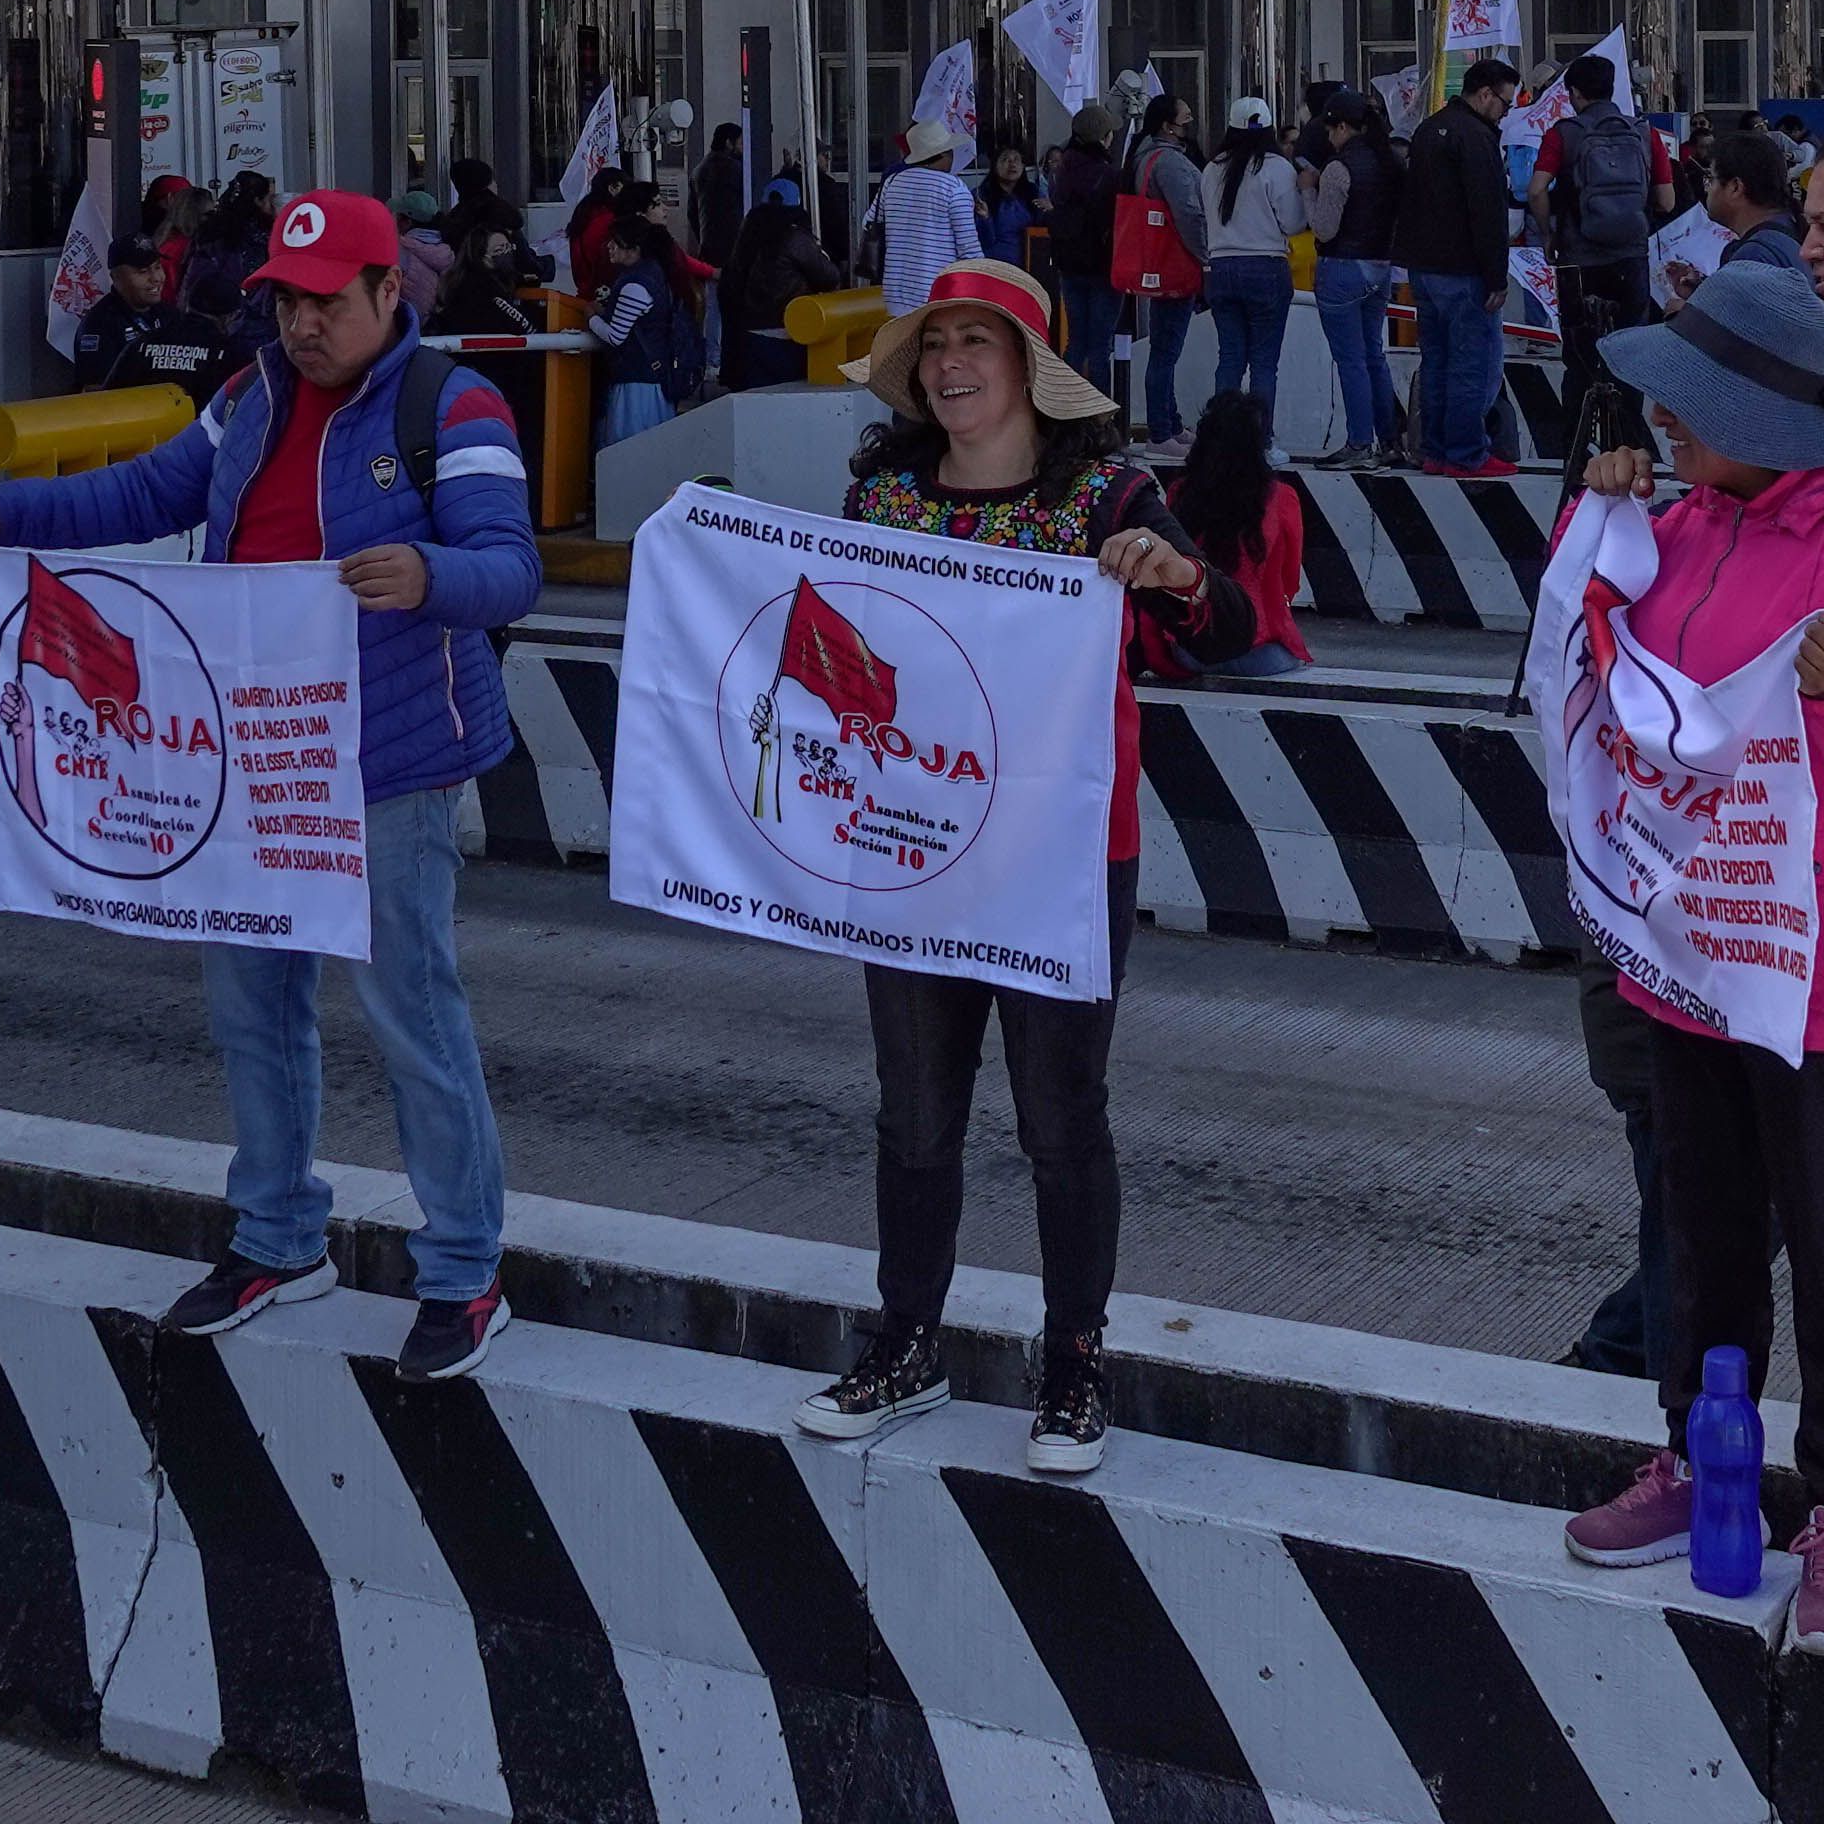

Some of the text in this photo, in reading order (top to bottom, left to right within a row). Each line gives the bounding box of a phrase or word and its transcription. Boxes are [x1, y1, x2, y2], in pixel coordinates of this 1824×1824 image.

[152, 357, 197, 371] FEDERAL
[686, 505, 1083, 597] ASAMBLEA DE COORDINACIÓN SECCIÓN 10
[232, 687, 300, 708] AUMENTO A LAS
[92, 697, 222, 757] ROJA
[236, 715, 331, 741] NO AL PAGO EN UMA
[241, 752, 253, 773] EN
[255, 751, 267, 773] EL
[838, 711, 990, 786] ROJA
[55, 754, 110, 780] CNTE
[114, 773, 201, 808] Asamblea de
[249, 782, 287, 804] PRONTA
[288, 782, 295, 803] Y
[798, 772, 856, 802] CNTE
[1737, 779, 1768, 806] UMA
[254, 815, 283, 835] BAJOS
[283, 814, 323, 836] INTERESES
[861, 793, 959, 834] Asamblea de
[87, 815, 175, 856] Sección 10
[849, 809, 948, 852] Coordinación
[1728, 813, 1787, 847] ATENCIÓN
[259, 843, 292, 870] PENSIÓN
[335, 852, 347, 874] NO
[833, 822, 925, 871] Sección 10
[1711, 859, 1775, 887] Y EXPEDITA
[96, 898, 105, 917] Y
[107, 900, 198, 930] ORGANIZADOS
[201, 908, 292, 936] ¡VENCEREMOS!
[1705, 895, 1777, 927] INTERESES EN
[662, 878, 1071, 984] UNIDOS Y ORGANIZADOS ¡VENCEREMOS!
[1778, 947, 1789, 972] NO
